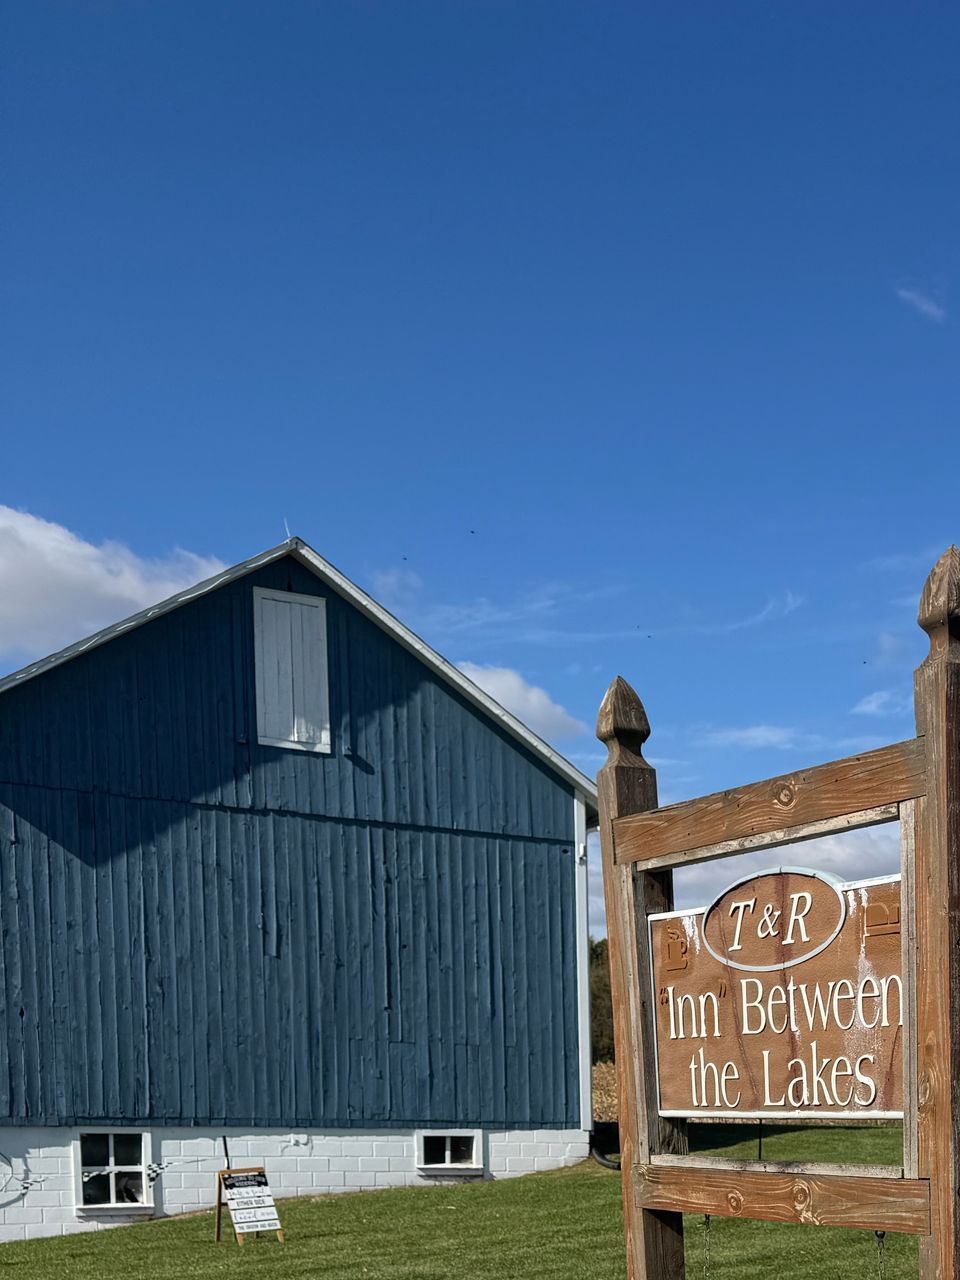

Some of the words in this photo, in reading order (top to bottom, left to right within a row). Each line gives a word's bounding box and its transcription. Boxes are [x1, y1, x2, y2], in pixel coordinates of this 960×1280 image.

[740, 975, 904, 1035] Between
[689, 1047, 742, 1108] the
[762, 1040, 877, 1108] Lakes
